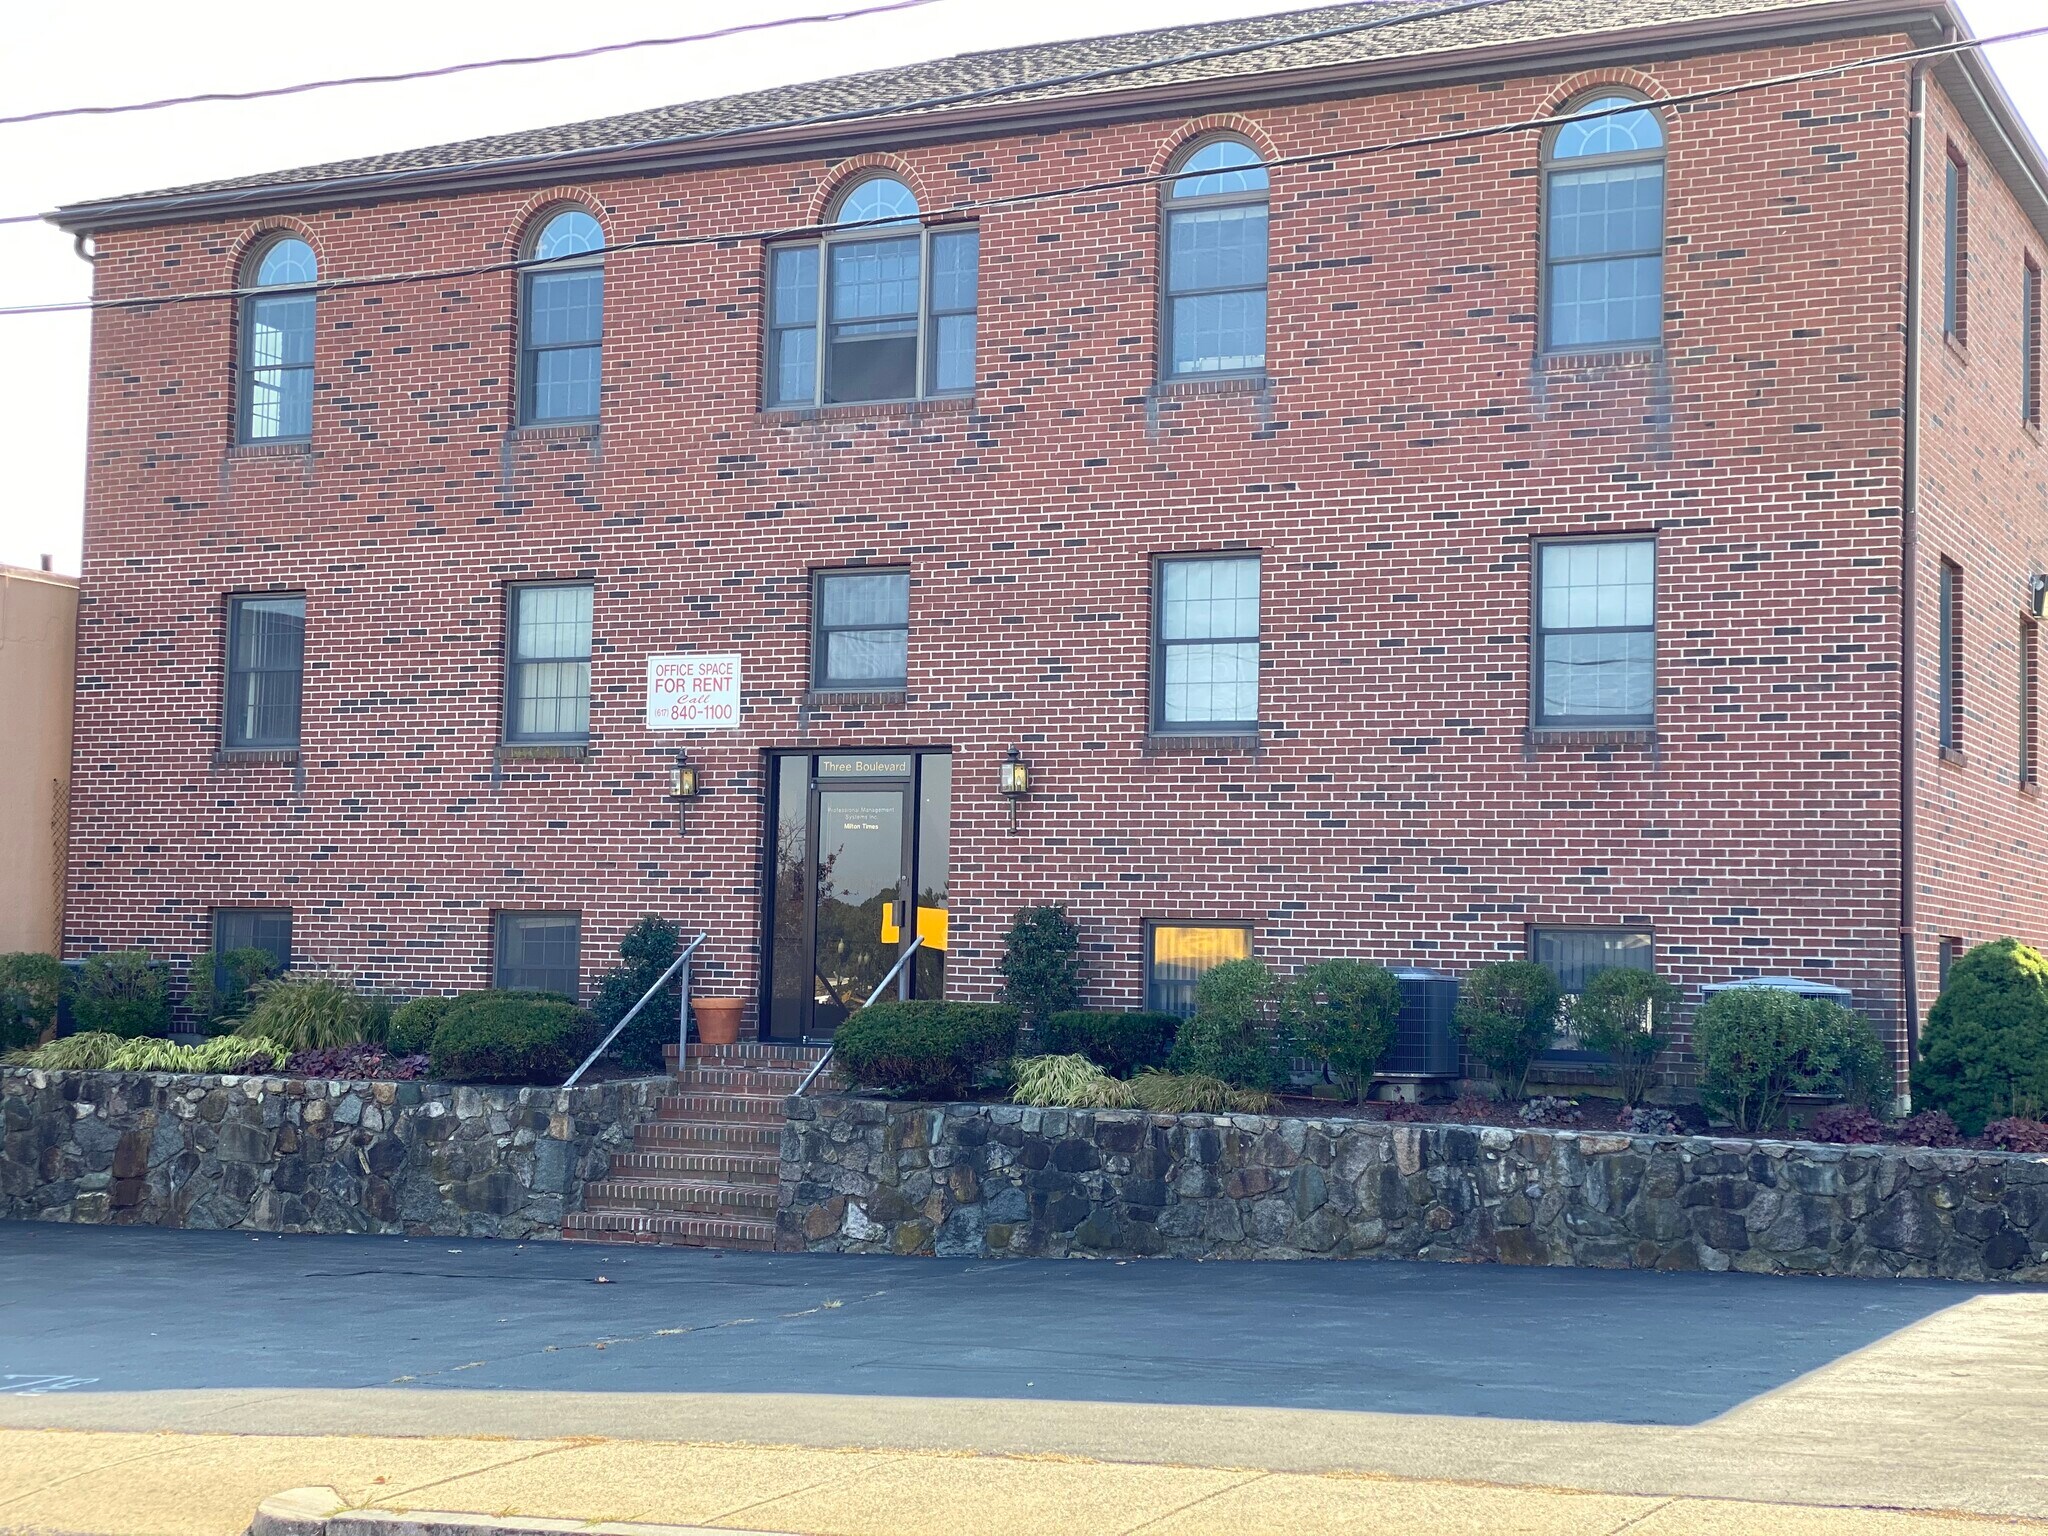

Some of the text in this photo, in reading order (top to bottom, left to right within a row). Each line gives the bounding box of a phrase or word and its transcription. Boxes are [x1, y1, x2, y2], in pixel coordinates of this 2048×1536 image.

[656, 663, 733, 677] OFFICE SPACE
[655, 677, 733, 693] FOR RENT
[677, 695, 711, 704] Call
[655, 704, 732, 720] (617) 840-1100
[823, 761, 906, 772] Three Boulevard
